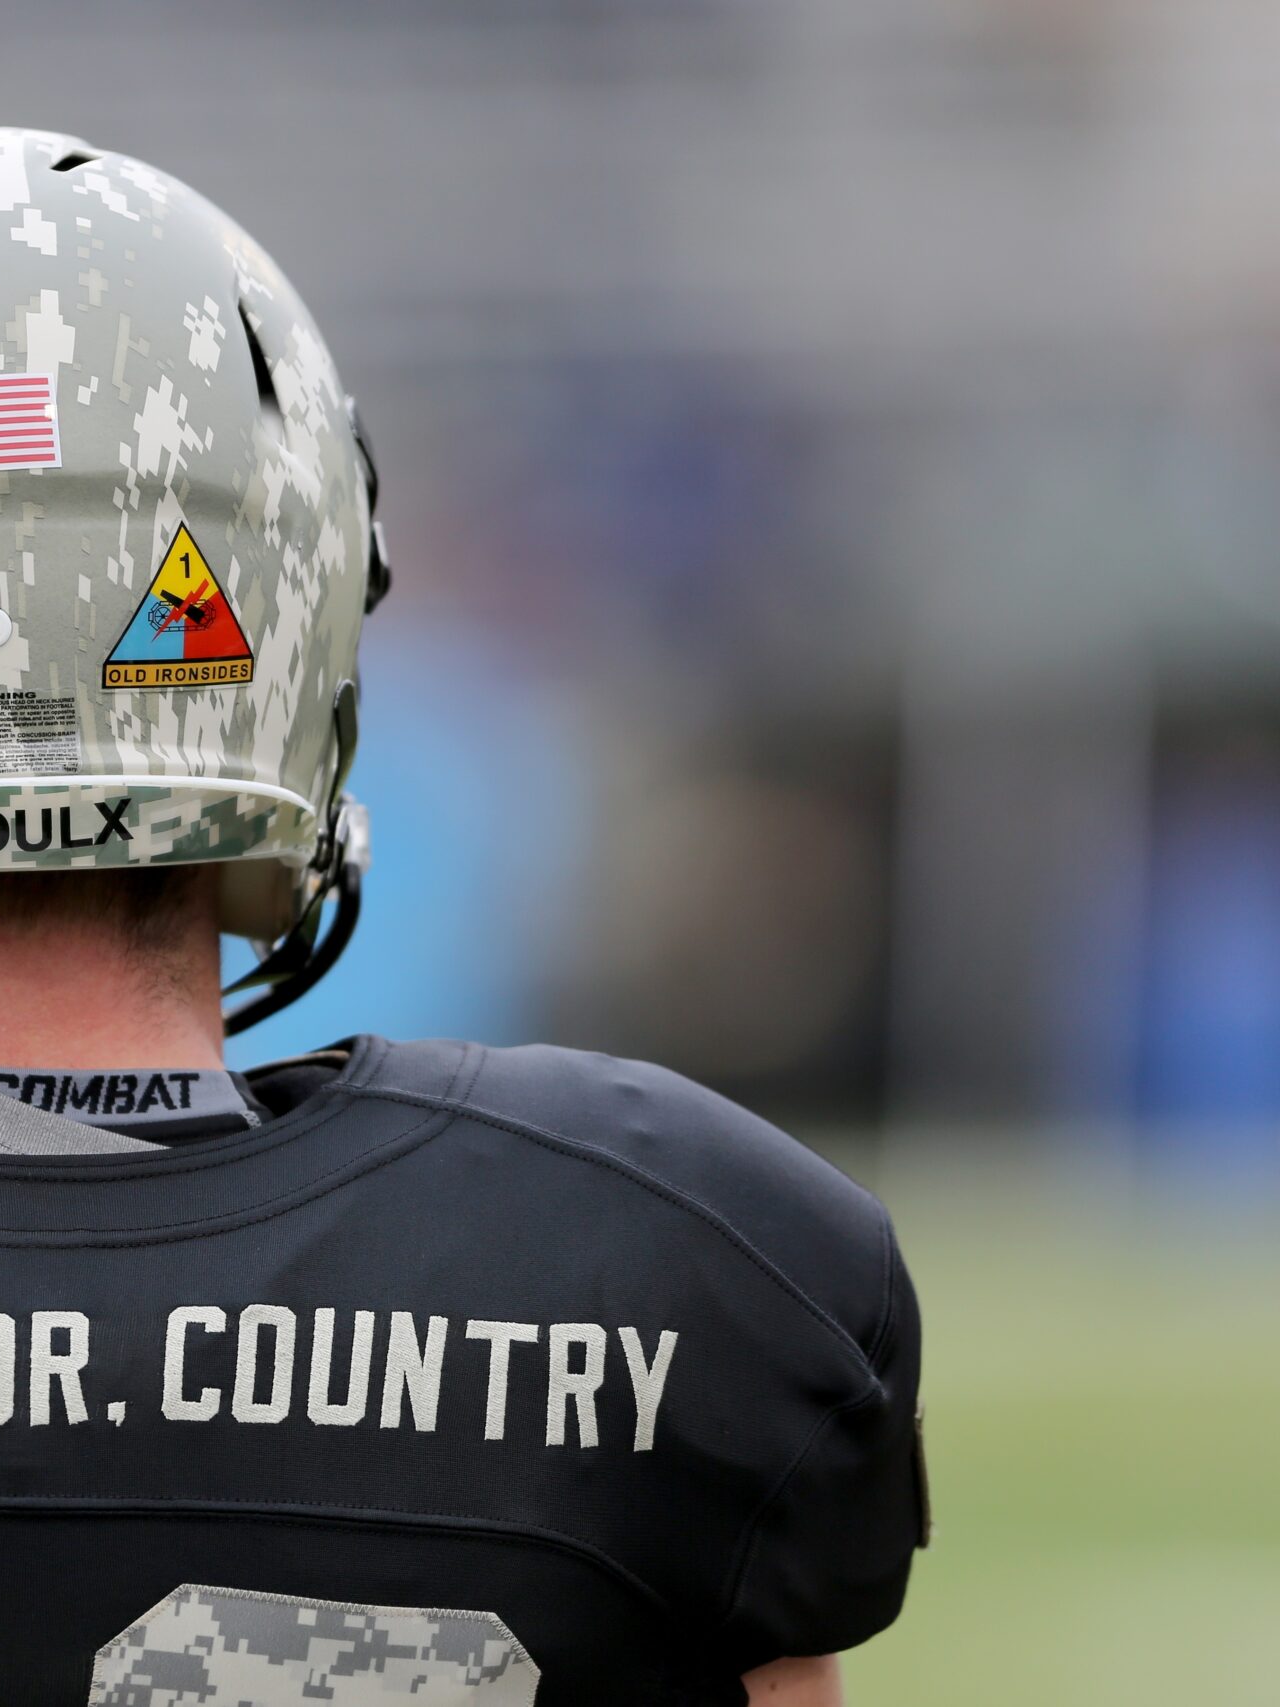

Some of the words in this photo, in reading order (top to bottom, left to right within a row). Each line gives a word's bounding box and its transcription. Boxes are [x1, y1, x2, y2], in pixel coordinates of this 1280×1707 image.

[180, 553, 190, 578] 1
[108, 670, 147, 683] OLD
[155, 664, 249, 682] IRONSIDES
[161, 1304, 679, 1452] COUNTRY
